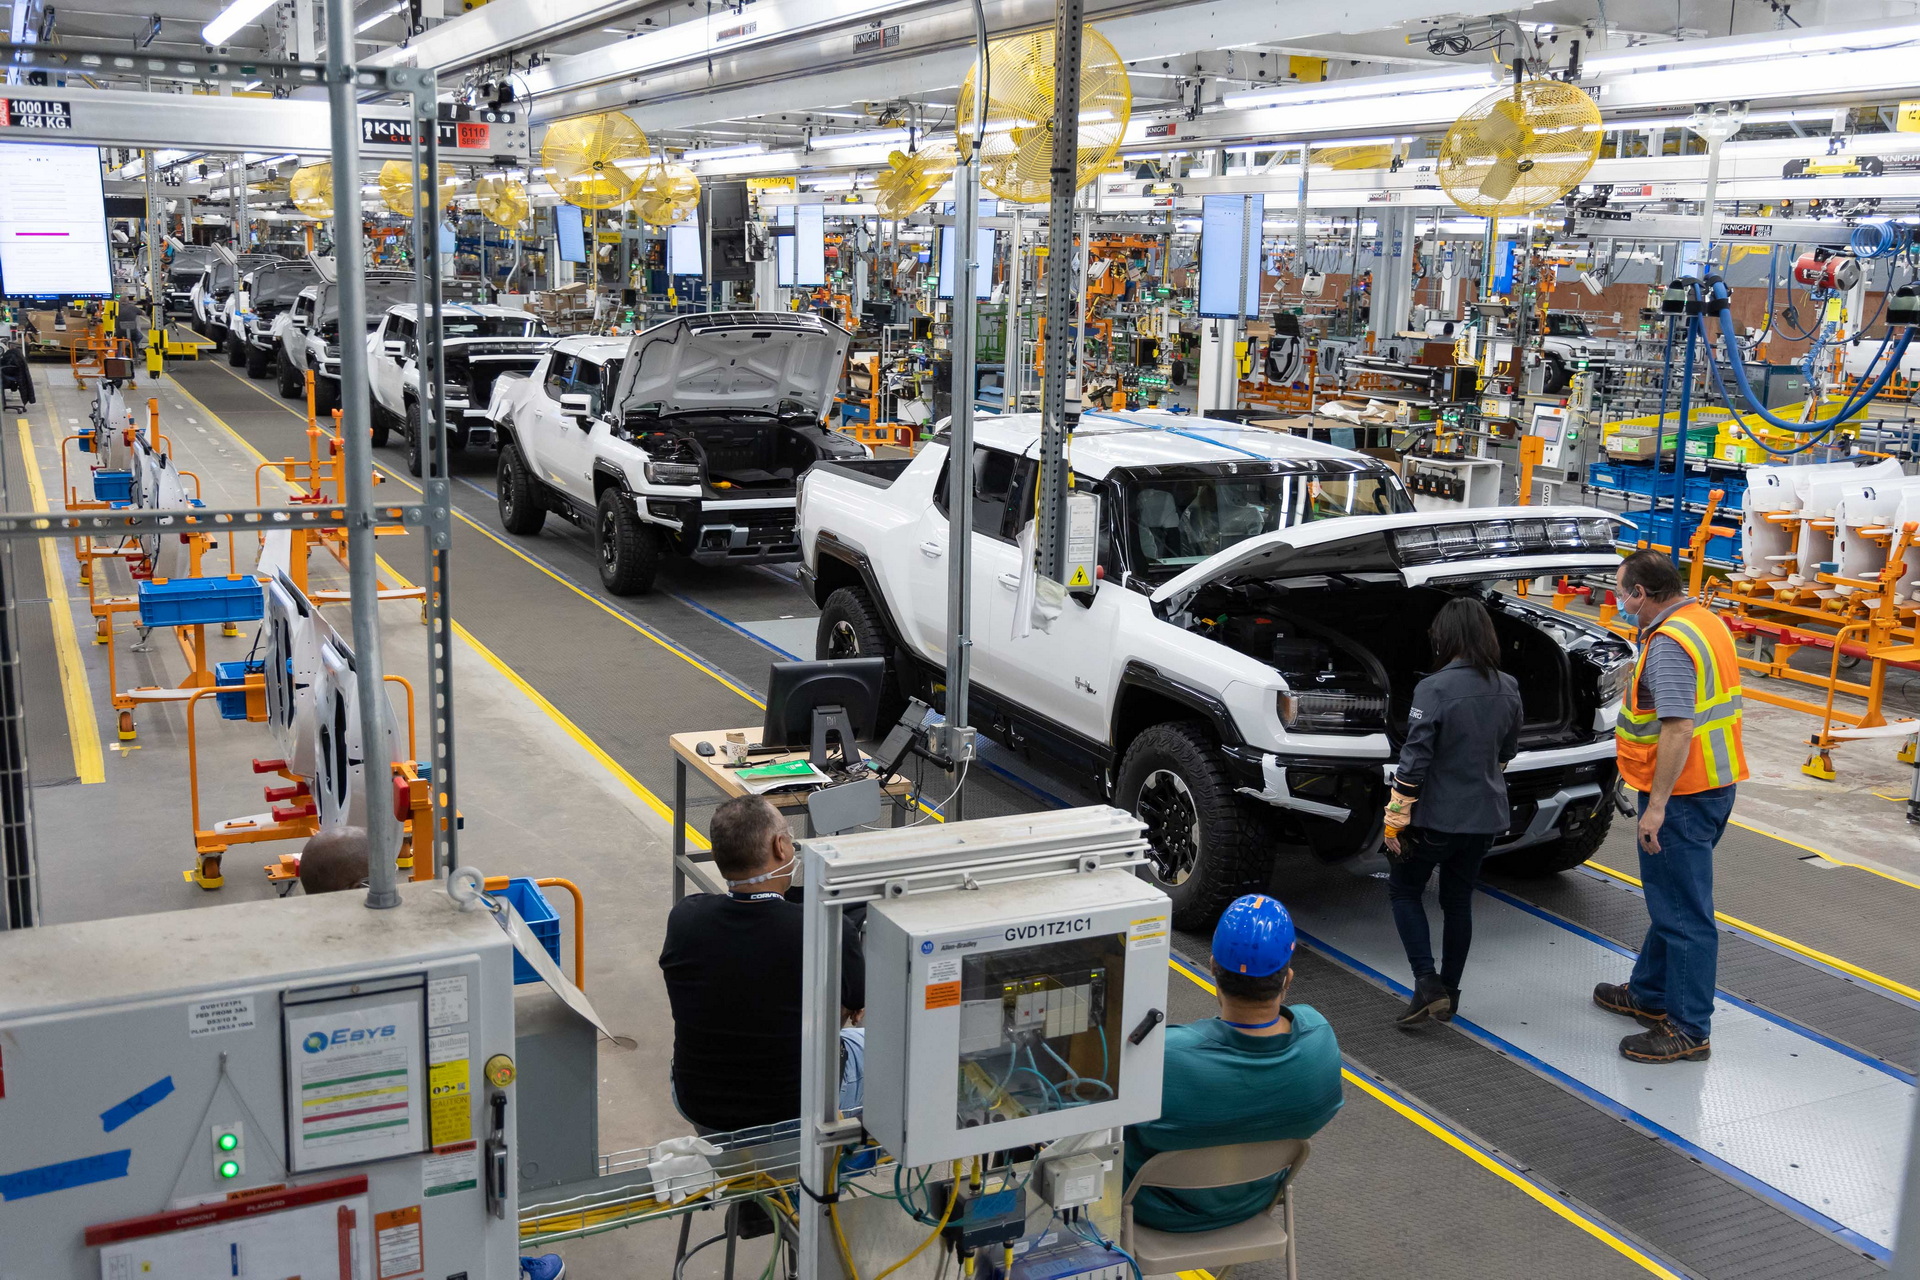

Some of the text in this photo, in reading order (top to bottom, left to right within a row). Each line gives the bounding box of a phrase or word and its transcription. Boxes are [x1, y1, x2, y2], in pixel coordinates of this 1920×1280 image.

[856, 30, 880, 44] KNIGHT
[12, 100, 67, 115] 1000 LB.
[20, 115, 70, 129] 454 KG.
[375, 121, 455, 138] KNIT
[461, 126, 486, 138] 6110
[1147, 125, 1168, 134] KNIGHT
[1881, 154, 1920, 163] KNIGHT
[1005, 918, 1091, 941] GVD1TZ1C1
[941, 941, 977, 951] Allen-Bradley
[246, 1201, 286, 1212] PLACARD
[176, 1212, 217, 1225] LOCKOUT
